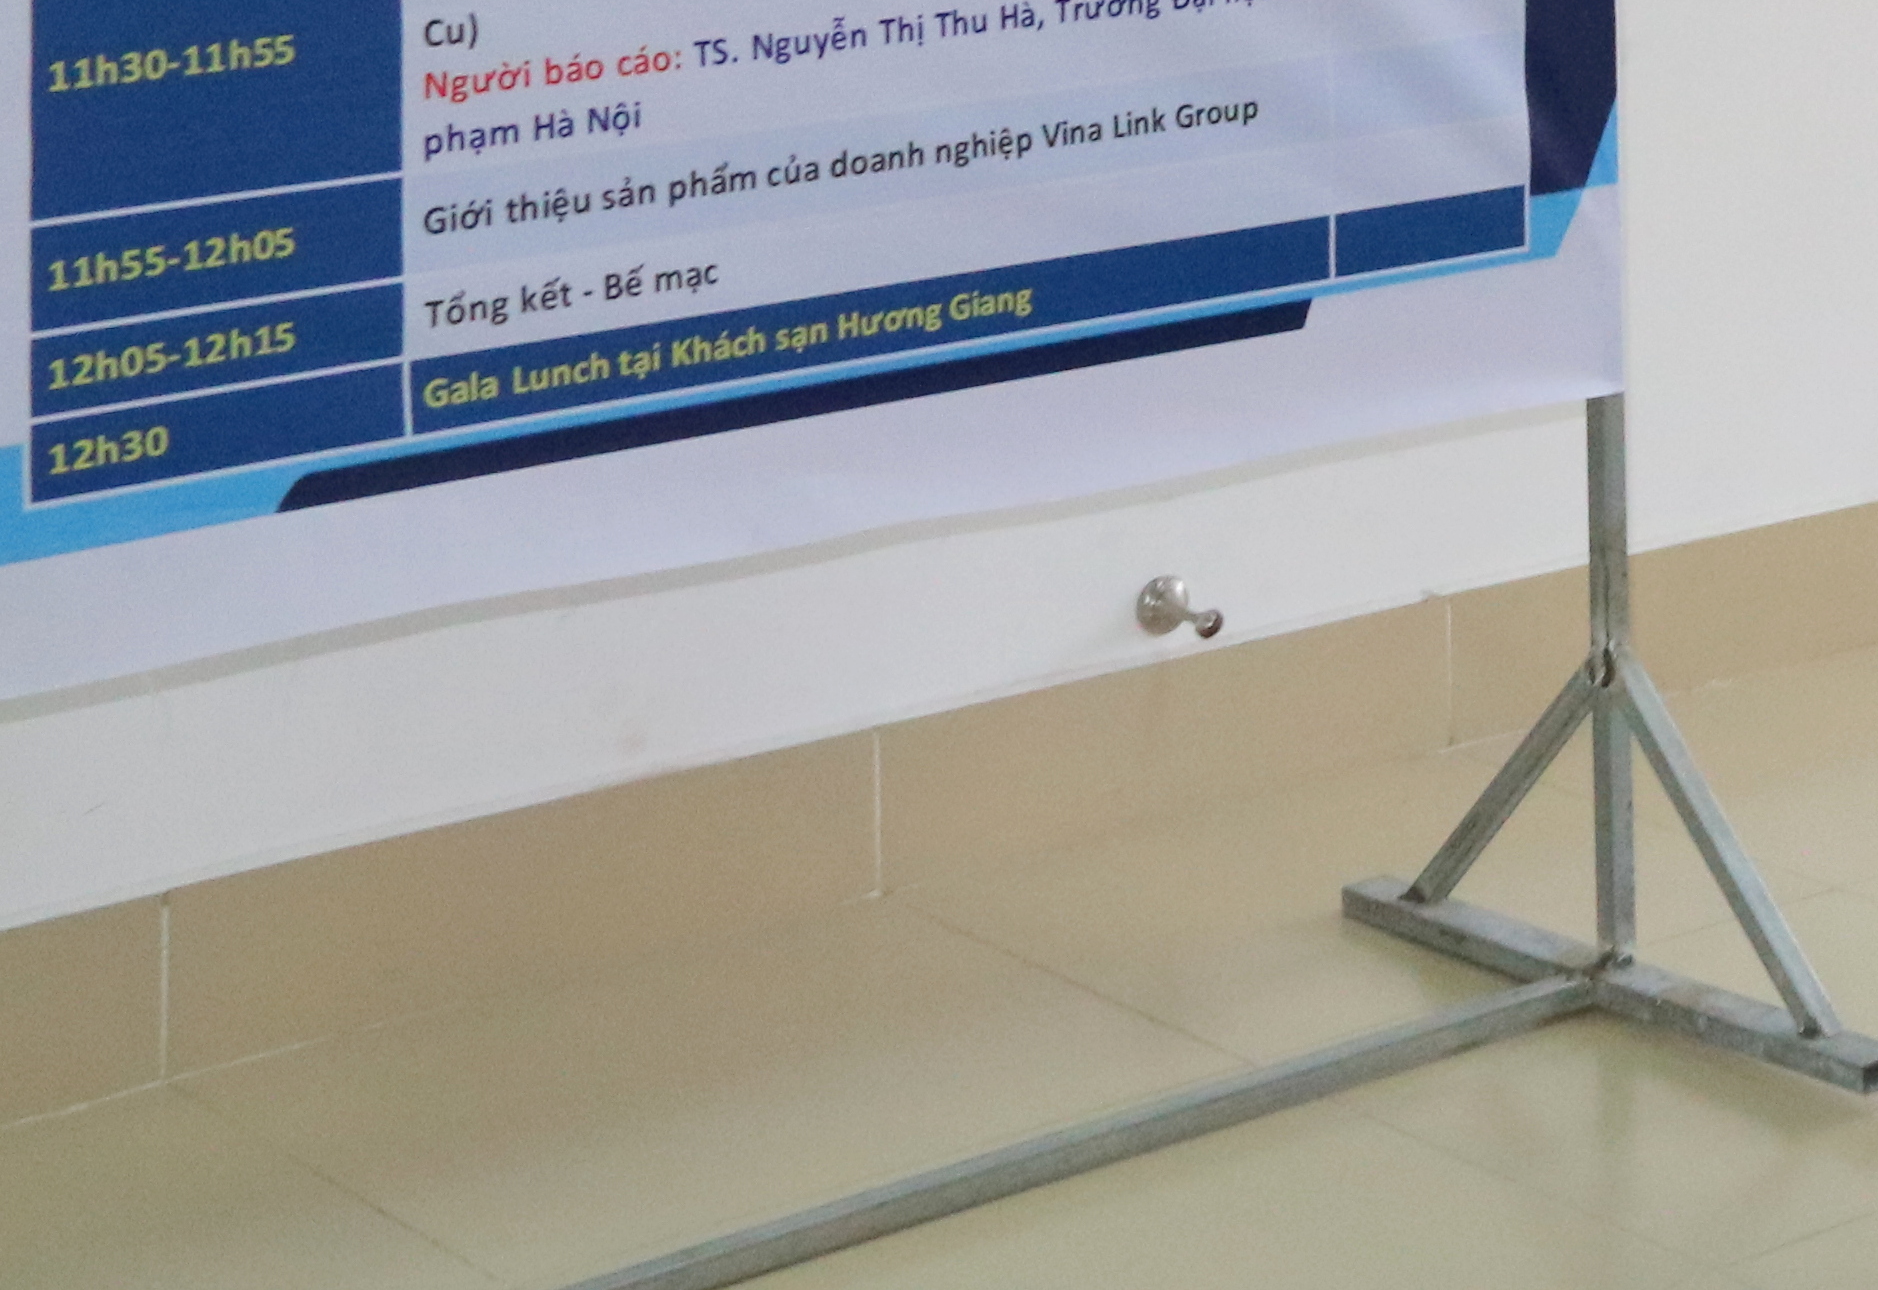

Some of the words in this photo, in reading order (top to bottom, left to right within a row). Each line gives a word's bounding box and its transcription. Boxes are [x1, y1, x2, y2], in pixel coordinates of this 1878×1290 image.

[423, 12, 479, 49] Cu)
[49, 34, 295, 92] 11h30-11h55
[424, 122, 520, 161] phạm
[534, 109, 575, 141] Hà
[587, 101, 640, 136] Nội
[423, 198, 492, 235] Giới
[506, 187, 591, 223] thiệu
[602, 176, 656, 210] sản
[766, 154, 820, 187] của
[830, 140, 924, 179] doanh
[935, 127, 1033, 168] nghiệp
[1041, 119, 1103, 148] Vina
[1113, 107, 1166, 139] Link
[1175, 100, 1259, 129] Group
[49, 227, 295, 291] 11h55-12h05
[521, 276, 572, 313] kết
[604, 263, 644, 301] Bế
[654, 263, 718, 293] mạc
[49, 321, 295, 390] 12h05-12h15
[423, 370, 499, 408] Gala
[513, 351, 610, 394] Lunch
[618, 342, 660, 379] tại
[672, 326, 766, 366] Khách
[775, 321, 828, 353] sạn
[838, 303, 942, 340] Hương
[949, 288, 1032, 320] Giang
[49, 425, 169, 475] 12h30
